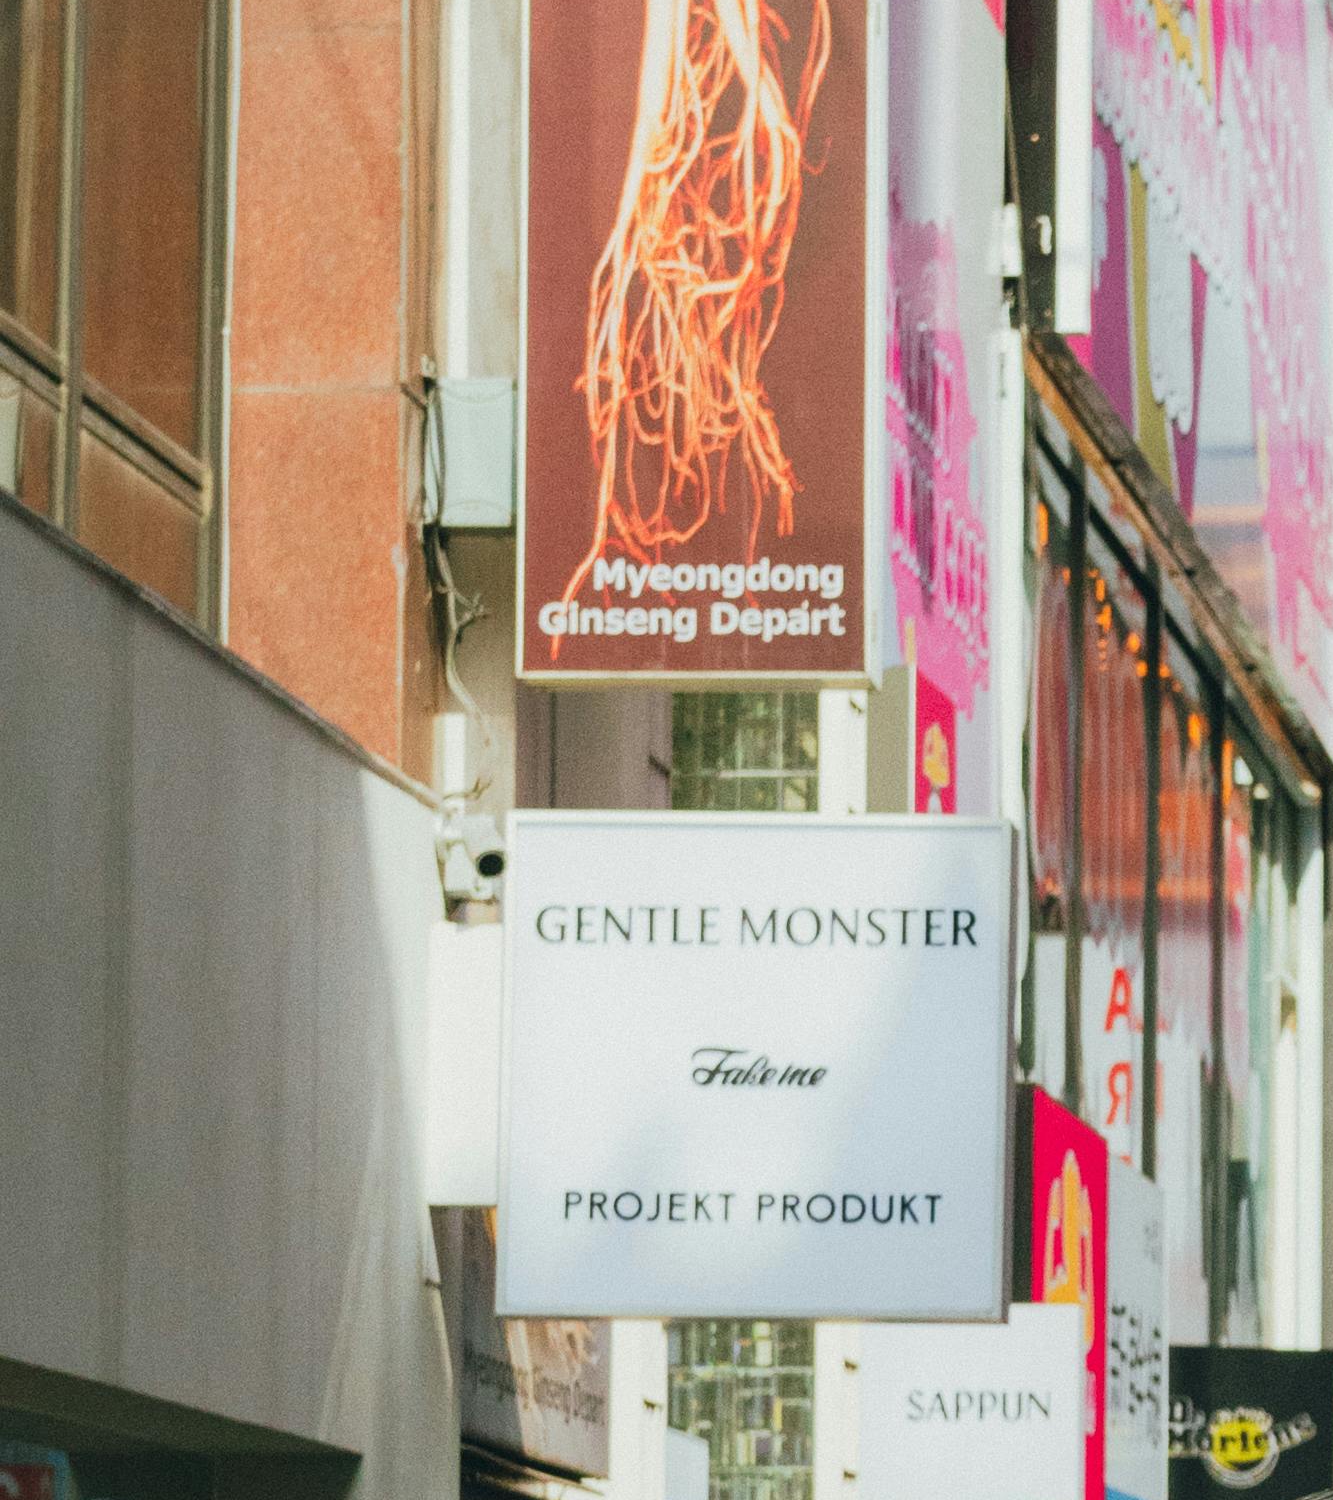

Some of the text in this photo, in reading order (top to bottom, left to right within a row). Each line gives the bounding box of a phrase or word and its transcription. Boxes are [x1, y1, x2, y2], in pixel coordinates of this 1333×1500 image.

[593, 557, 845, 597] Myeongdong
[537, 602, 847, 643] Ginseng Depart
[535, 905, 979, 948] GENTLE MONSTER
[562, 1190, 943, 1225] PROJEKT PRODUKT
[907, 1390, 1052, 1422] SAPPUN
